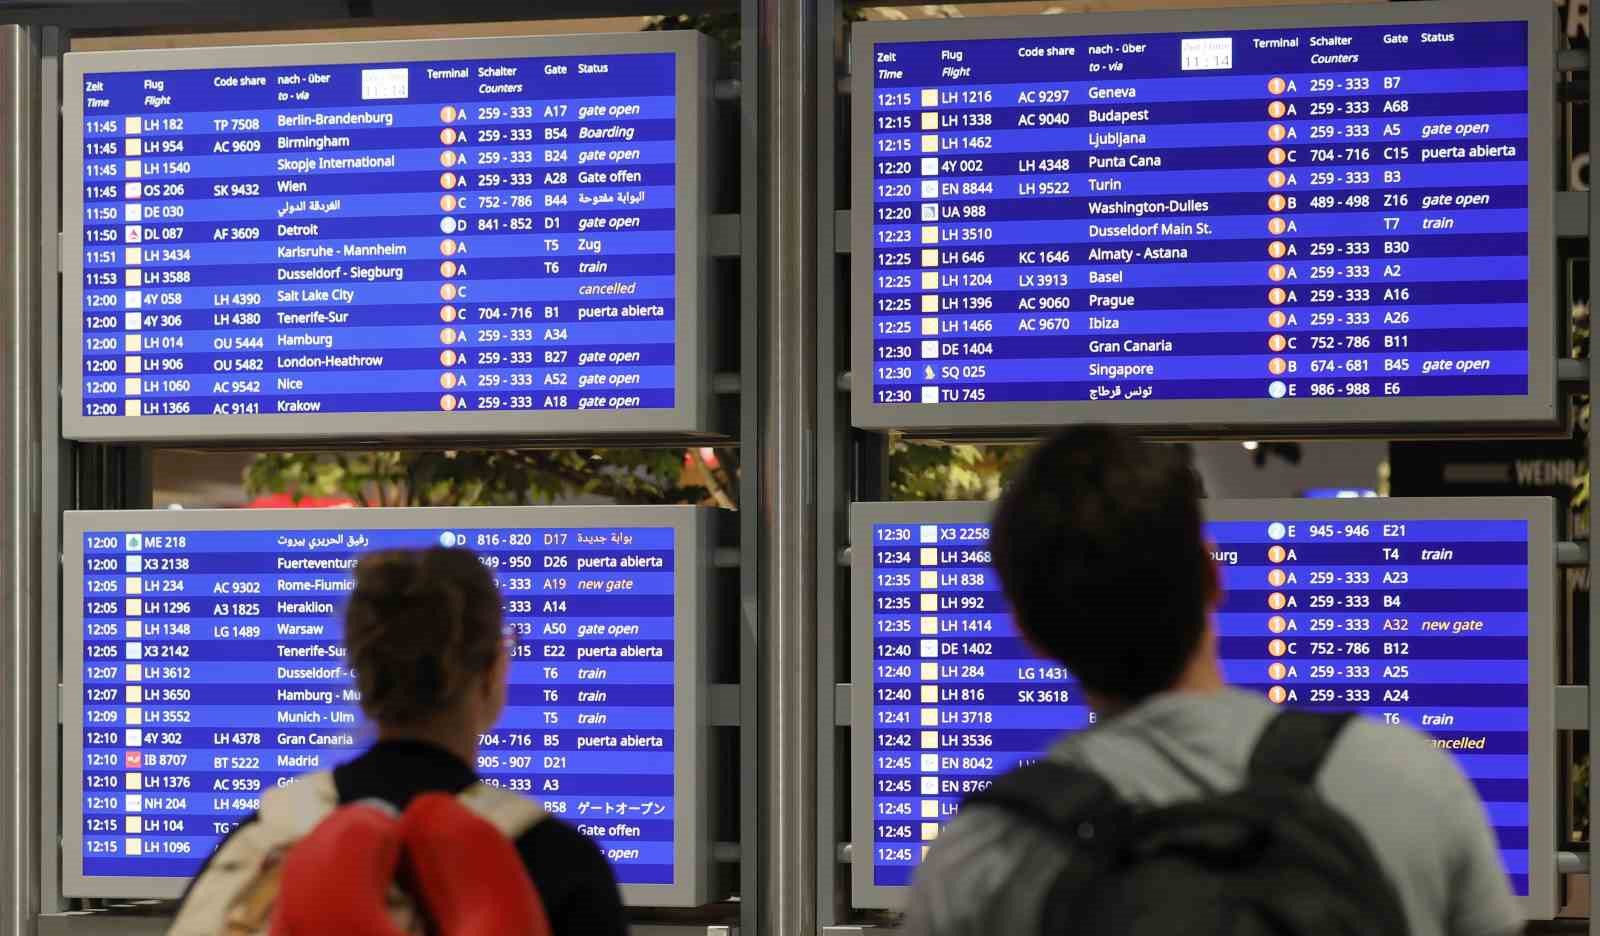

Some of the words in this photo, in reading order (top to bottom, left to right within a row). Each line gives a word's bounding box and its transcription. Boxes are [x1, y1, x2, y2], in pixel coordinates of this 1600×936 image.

[1254, 38, 1298, 49] Terminal
[1311, 36, 1352, 47] Schalter
[1384, 34, 1408, 44] Gate
[1422, 33, 1454, 43] Status
[1019, 47, 1044, 57] Code
[1047, 46, 1074, 56] share
[1089, 44, 1112, 55] nach
[1123, 43, 1146, 54] über
[878, 52, 896, 63] Zeit
[942, 51, 962, 62] Flug
[1311, 54, 1358, 64] Counters
[479, 67, 516, 78] Schalter
[545, 64, 566, 75] Gate
[579, 63, 608, 74] Status
[1089, 63, 1100, 72] to
[1109, 61, 1122, 72] via
[278, 74, 300, 85] nach
[309, 73, 330, 84] über
[428, 68, 468, 79] Terminal
[879, 70, 902, 80] Time
[943, 67, 970, 79] Flight
[87, 81, 103, 92] Zeit
[145, 80, 163, 92] Flug
[215, 76, 237, 87] Code
[240, 75, 265, 86] share
[479, 83, 522, 94] Counters
[1089, 87, 1135, 99] Geneva
[278, 92, 289, 101] to
[296, 90, 309, 101] via
[88, 98, 109, 108] Time
[145, 96, 170, 108] Flight
[579, 106, 606, 119] gate
[609, 106, 639, 118] open
[1090, 110, 1148, 124] Budapest
[278, 112, 392, 126] Berlin-Brandenburg
[579, 126, 634, 140] Boarding
[1422, 124, 1452, 138] gate
[1455, 124, 1489, 136] open
[278, 136, 349, 150] Birmingham
[1090, 133, 1145, 148] Ljubljana
[579, 151, 606, 164] gate
[609, 150, 639, 162] open
[1422, 147, 1465, 161] puerta
[1470, 145, 1515, 157] abierta
[278, 158, 315, 172] Skopje
[320, 155, 394, 169] International
[1090, 157, 1125, 168] Punta
[1130, 156, 1160, 167] Cana
[579, 172, 606, 183] Gate
[610, 170, 640, 182] offen
[278, 181, 306, 193] Wien
[1089, 179, 1121, 191] Turin
[1423, 195, 1452, 208] gate
[1456, 195, 1489, 207] open
[1089, 200, 1208, 216] Washington-Dulles
[579, 218, 606, 231] gate
[609, 218, 639, 230] open
[1423, 217, 1453, 229] train
[278, 224, 317, 236] Detroit
[1090, 224, 1158, 237] Dusseldorf
[1162, 224, 1192, 236] Main
[1197, 223, 1211, 235] St.
[278, 246, 333, 258] Karlsruhe
[344, 244, 406, 256] Mannheim
[578, 239, 600, 253] Zug
[1089, 249, 1132, 262] Almaty
[1144, 248, 1187, 259] Astana
[580, 262, 607, 273] train
[278, 267, 340, 280] Dusseldorf
[351, 267, 402, 281] Siegburg
[1090, 271, 1122, 283] Basel
[579, 283, 636, 295] cancelled
[278, 291, 299, 302] Salt
[302, 290, 328, 302] Lake
[332, 289, 353, 303] City
[1090, 295, 1134, 309] Prague
[278, 312, 348, 324] Tenerife-Sur
[579, 307, 617, 320] puerta
[622, 305, 663, 317] abierta
[1090, 318, 1118, 330] Ibiza
[278, 334, 332, 348] Hamburg
[1090, 341, 1119, 353] Gran
[1124, 340, 1171, 352] Canaria
[278, 355, 382, 368] London-Heathrow
[579, 352, 606, 365] gate
[609, 353, 639, 365] open
[1090, 364, 1153, 378] Singapore
[1423, 360, 1452, 373] gate
[1456, 360, 1489, 372] open
[278, 378, 302, 390] Nice
[278, 401, 320, 412] Krakow
[878, 529, 910, 541] 12:30
[1422, 549, 1452, 561] train
[278, 558, 357, 569] Fuerteventura
[578, 557, 616, 570] puerta
[621, 556, 662, 568] abierta
[578, 580, 603, 590] new
[606, 580, 633, 592] gate
[878, 575, 910, 587] 12:35
[942, 575, 957, 586] LH
[962, 574, 984, 586] 838
[278, 602, 332, 613] Heraklion
[278, 624, 323, 635] Warsaw
[578, 625, 605, 637] gate
[608, 626, 638, 638] open
[942, 620, 957, 632] LH
[963, 620, 992, 632] 1414
[1422, 621, 1450, 631] new
[1453, 621, 1483, 633] gate
[278, 645, 346, 657] Tenerife-Sur
[578, 647, 616, 659] puerta
[621, 646, 662, 657] abierta
[942, 643, 958, 655] DE
[963, 643, 992, 655] 1402
[579, 668, 606, 680] train
[878, 666, 911, 678] 12:40
[1019, 668, 1034, 680] LG
[1039, 668, 1066, 680] 1431
[278, 690, 332, 703] Hamburg
[942, 690, 957, 701] LH
[962, 689, 984, 701] 816
[1019, 691, 1033, 703] SK
[1038, 691, 1068, 703] 3618
[278, 711, 320, 723] Munich
[331, 712, 354, 723] Ulm
[1423, 714, 1453, 726] train
[278, 734, 305, 745] Gran
[309, 734, 353, 745] Canaria
[578, 736, 616, 749] puerta
[620, 736, 662, 747] abierta
[278, 755, 318, 767] Madrid
[578, 825, 605, 837] Gate
[609, 824, 639, 836] offen
[608, 850, 638, 862] open
[879, 849, 911, 861] 12:45
